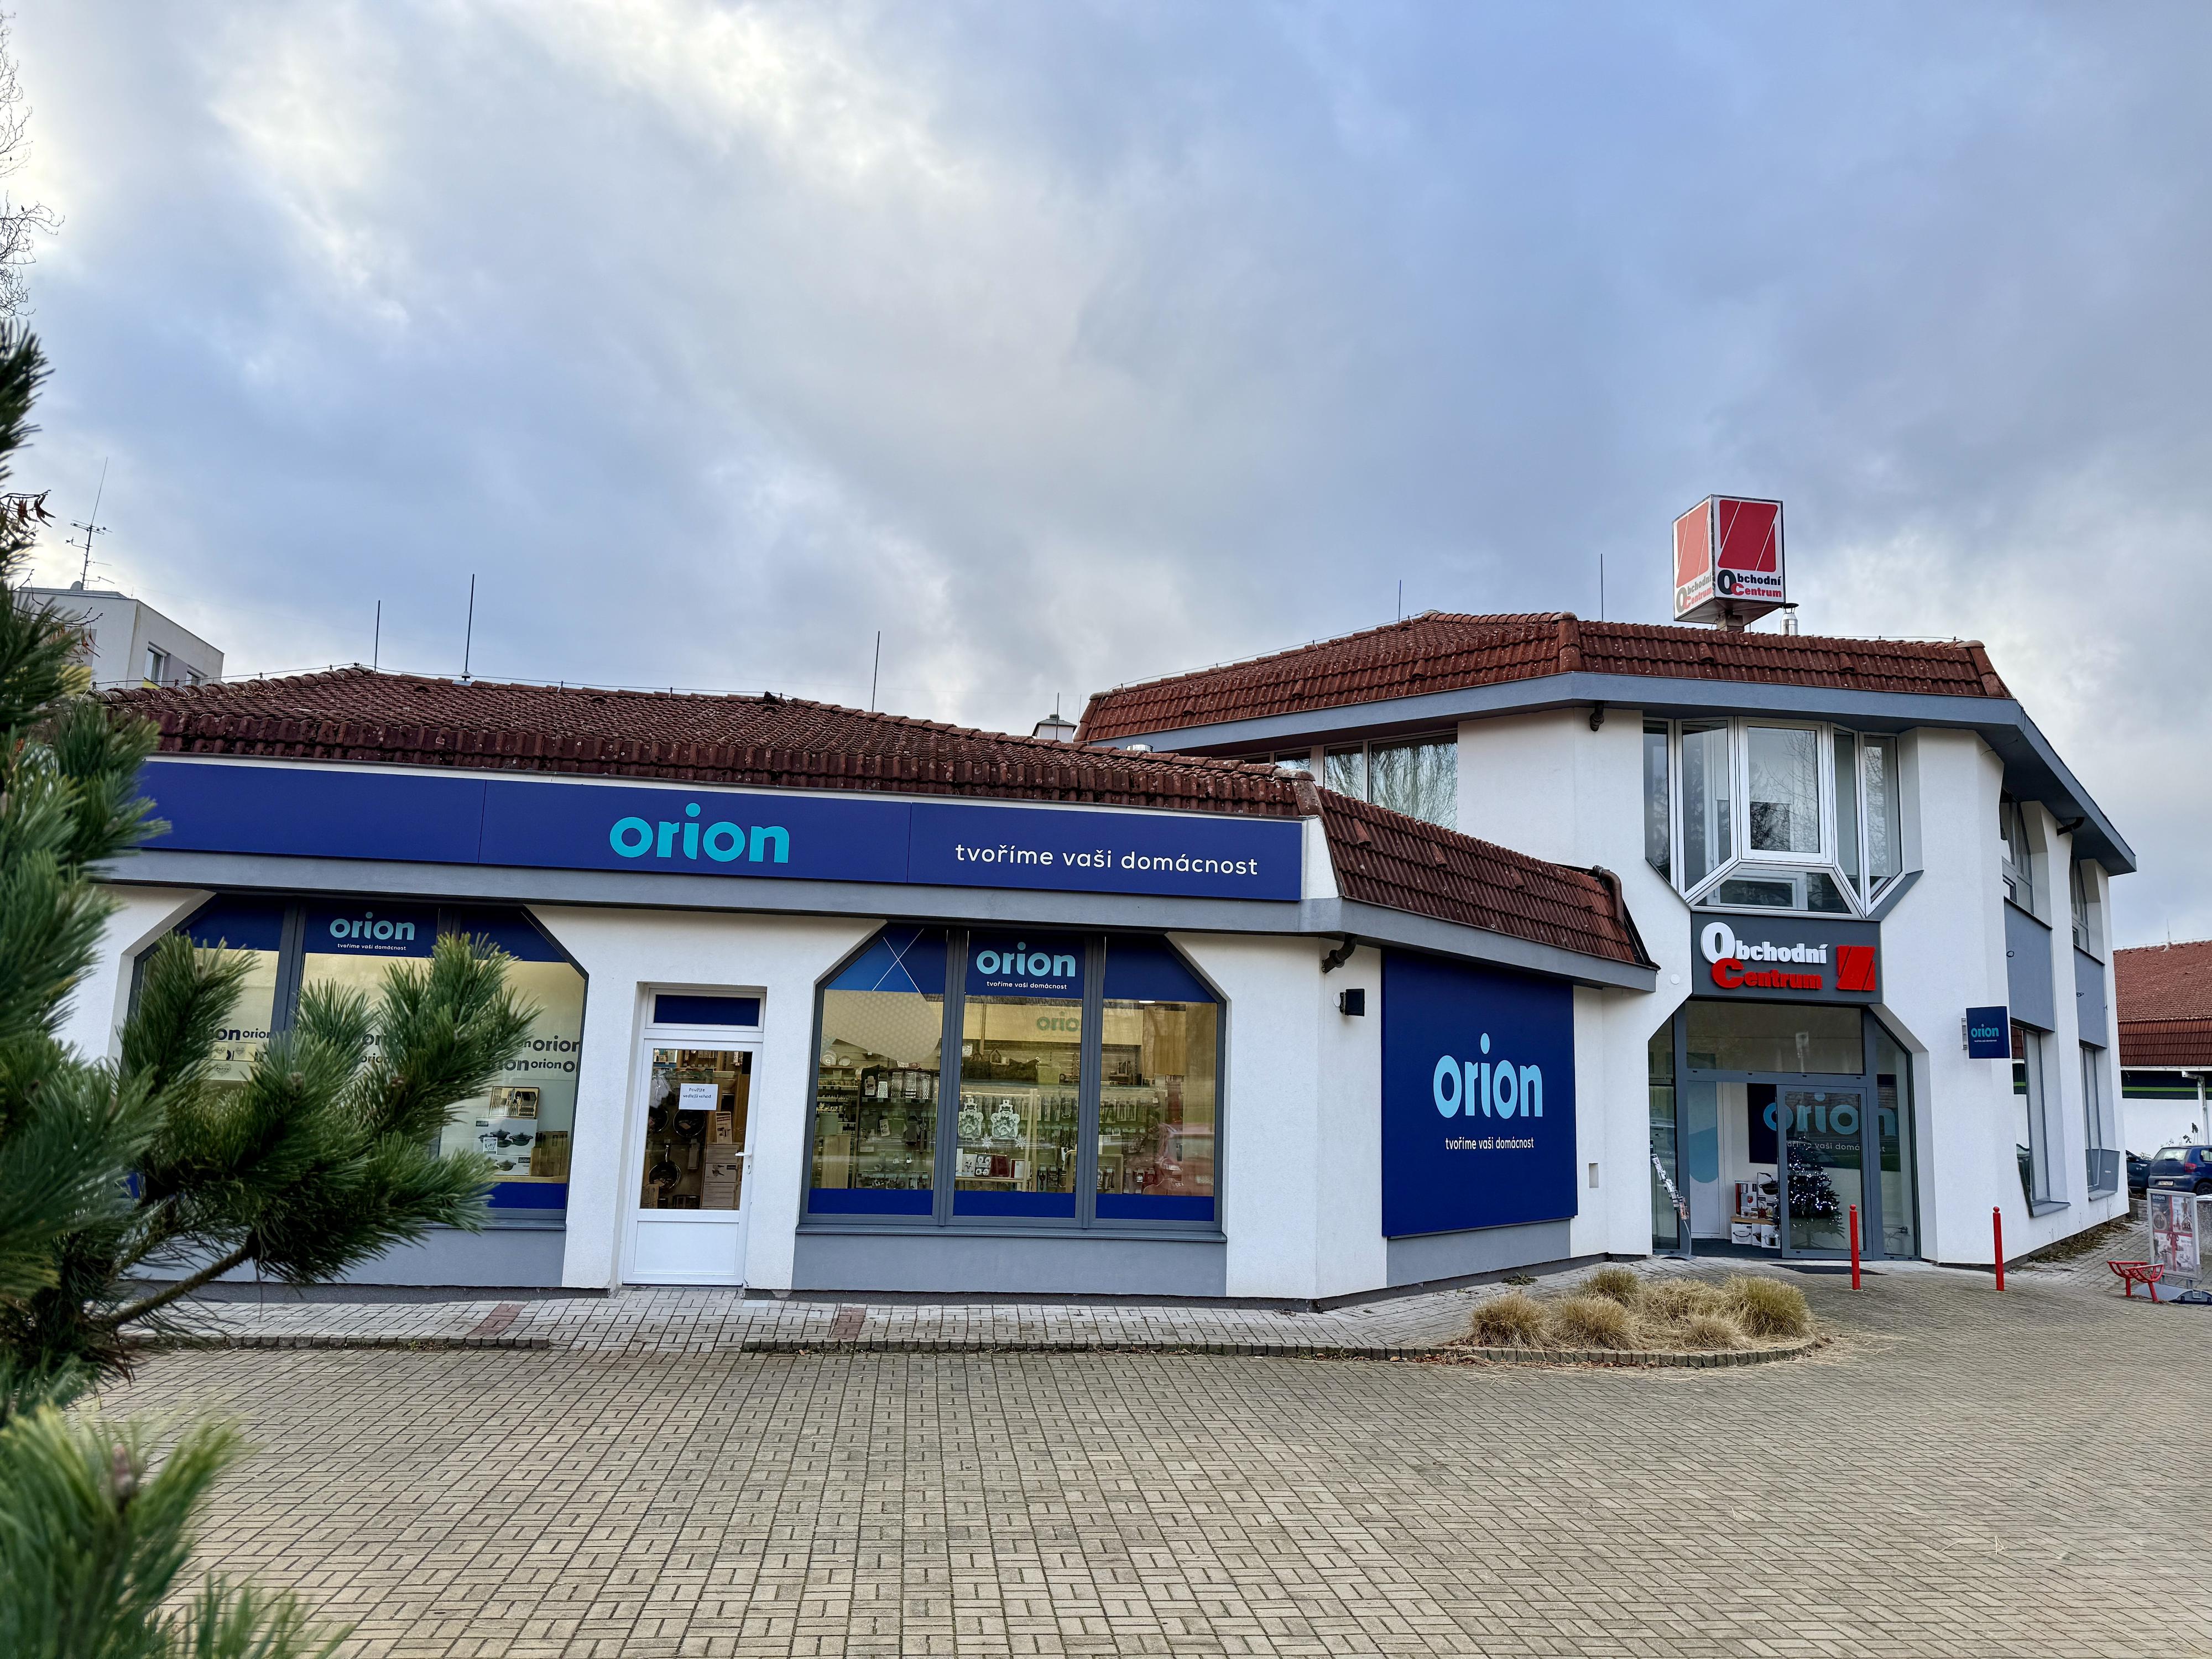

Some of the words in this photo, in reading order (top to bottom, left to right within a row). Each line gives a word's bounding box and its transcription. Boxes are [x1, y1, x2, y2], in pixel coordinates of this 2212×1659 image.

[1676, 572, 1712, 613] Obchodní
[1683, 587, 1712, 609] Centrum
[1717, 570, 1782, 595] Obchodní
[1730, 583, 1782, 597] Centrum
[609, 802, 790, 863] orion
[955, 843, 1053, 865] tvoříme
[1062, 849, 1112, 868] vaši
[1120, 851, 1258, 875] domácnost
[330, 911, 415, 940] orion
[1700, 922, 1828, 964] Obchodní
[976, 942, 1076, 977] orion
[1711, 958, 1823, 990] Centrum
[1971, 1024, 1999, 1038] orion
[530, 1058, 562, 1069] orion
[1433, 1032, 1543, 1119] orion
[1763, 1093, 1896, 1136] orion
[1445, 1136, 1477, 1149] tvoříme
[1479, 1136, 1494, 1149] vaši
[1496, 1136, 1534, 1149] domácnost
